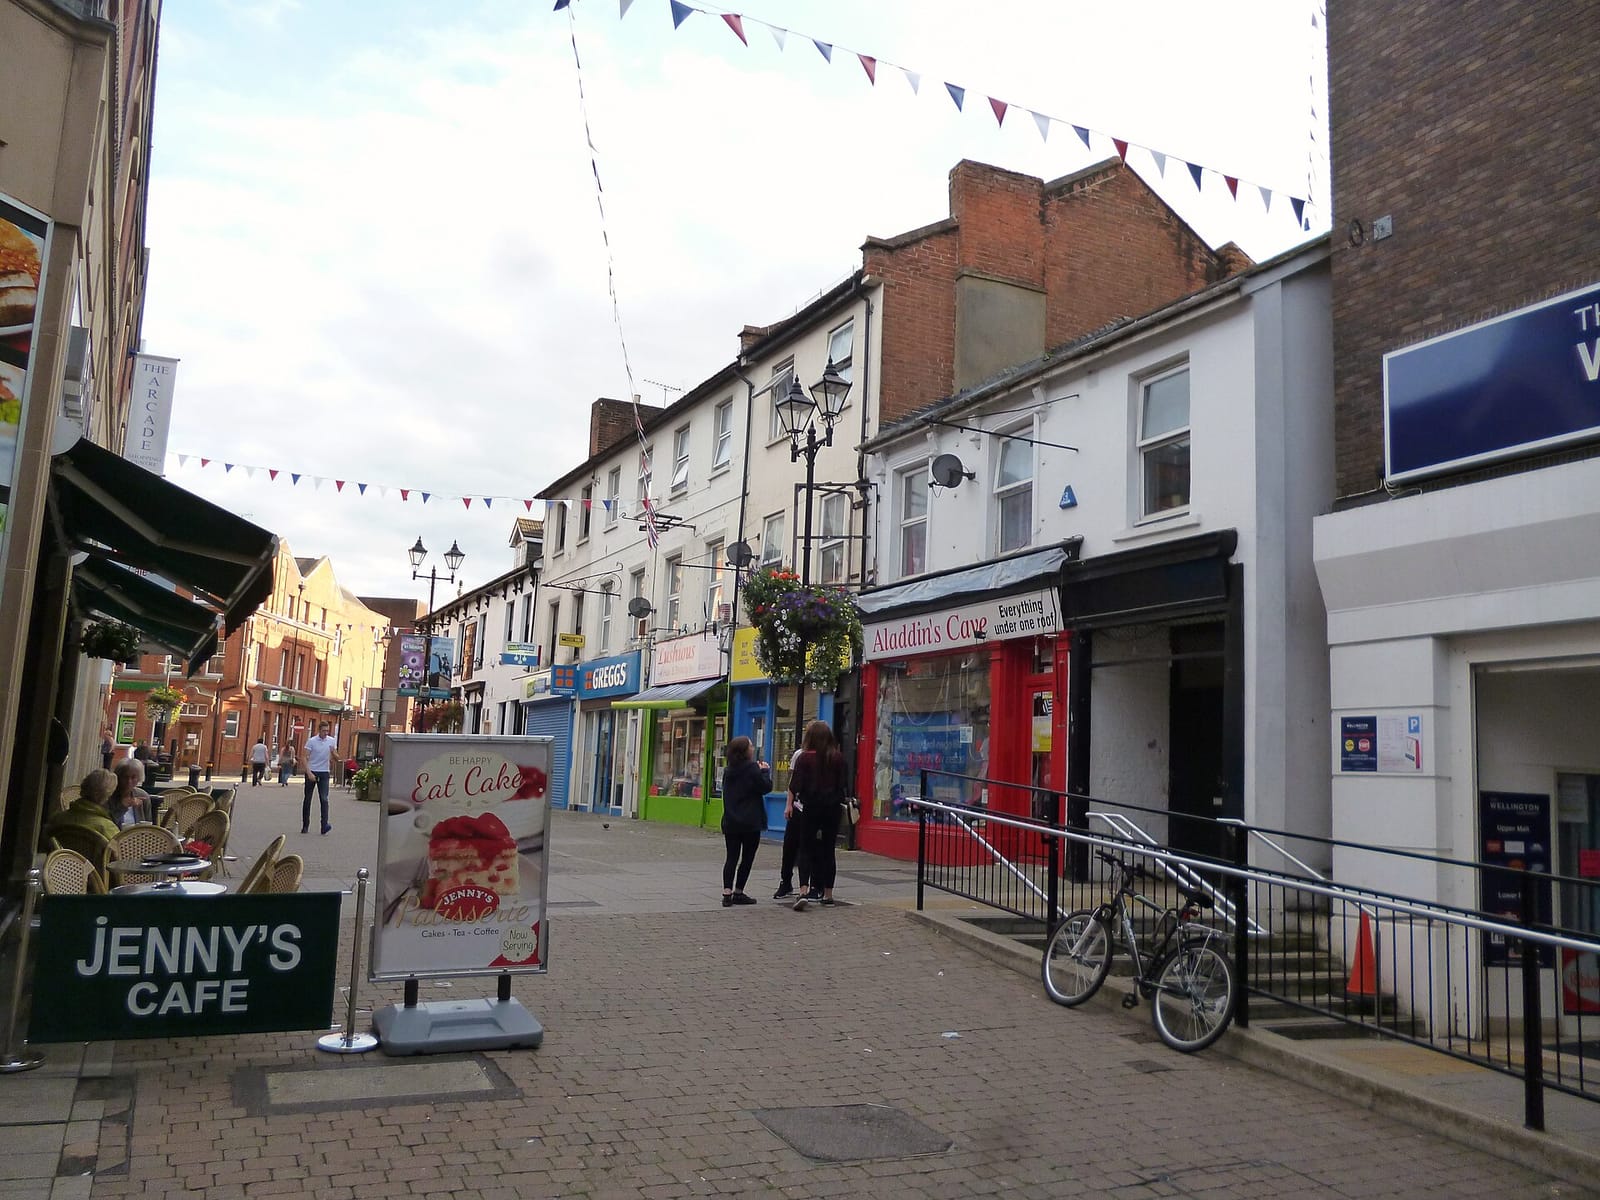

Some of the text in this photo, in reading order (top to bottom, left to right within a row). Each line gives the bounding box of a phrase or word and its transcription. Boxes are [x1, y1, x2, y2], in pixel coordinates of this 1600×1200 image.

[142, 363, 170, 375] THE
[140, 376, 160, 451] ARCADE
[998, 600, 1043, 618] Everything
[994, 612, 1055, 635] under one roof
[872, 614, 987, 652] Aladdin's Cave
[592, 662, 627, 690] GREGGS
[1410, 719, 1418, 730] P
[449, 756, 492, 765] BE HAPPY
[411, 762, 526, 803] Eat Cake
[1489, 801, 1540, 811] WELLINGTON
[443, 889, 495, 906] JENNY'S
[394, 893, 530, 929] Patisserie
[421, 927, 500, 939] Cakes Tea Coffee
[509, 929, 528, 940] Now
[502, 941, 534, 953] Serving
[126, 978, 250, 1016] CAFE
